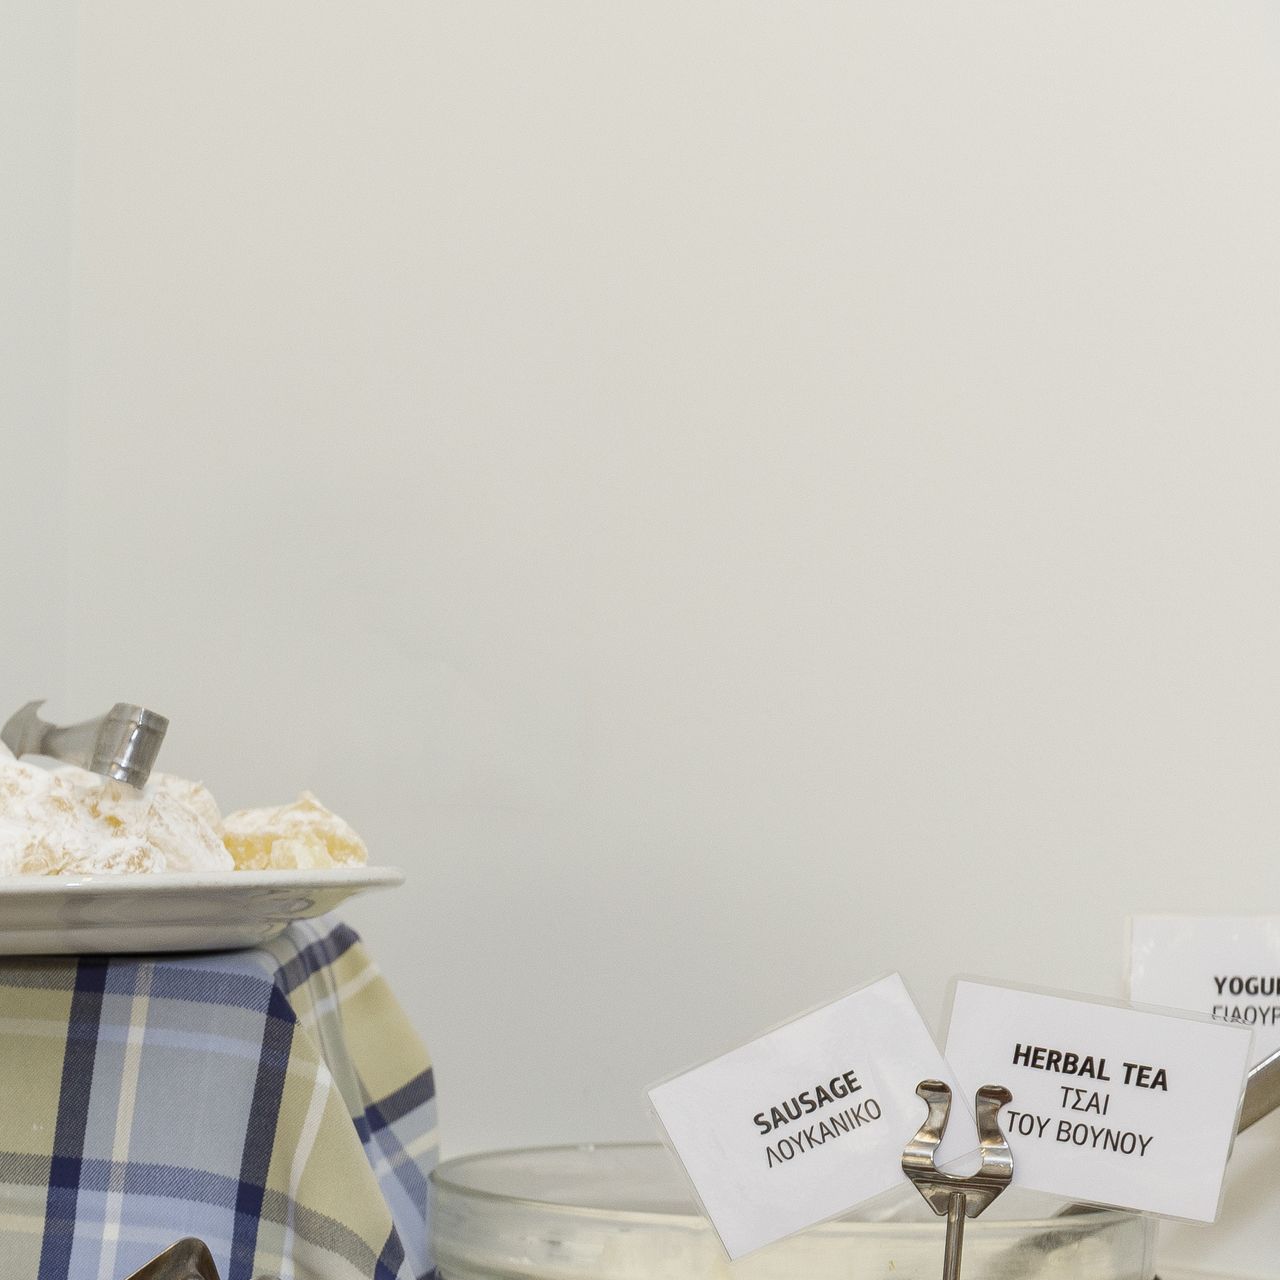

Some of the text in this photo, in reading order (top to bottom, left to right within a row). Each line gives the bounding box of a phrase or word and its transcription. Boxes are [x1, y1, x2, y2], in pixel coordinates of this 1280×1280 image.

[1214, 976, 1280, 997] YOGU
[1012, 1043, 1168, 1092] HERBAL TEA
[753, 1069, 862, 1135] SAUSAGE
[1060, 1085, 1110, 1116] ΤΣΑΙ
[765, 1097, 882, 1168] ΛΟΥΚΑΝΙΚΟ
[1007, 1110, 1154, 1157] ΤΟΥ ΒΟΥΝΟΥ
